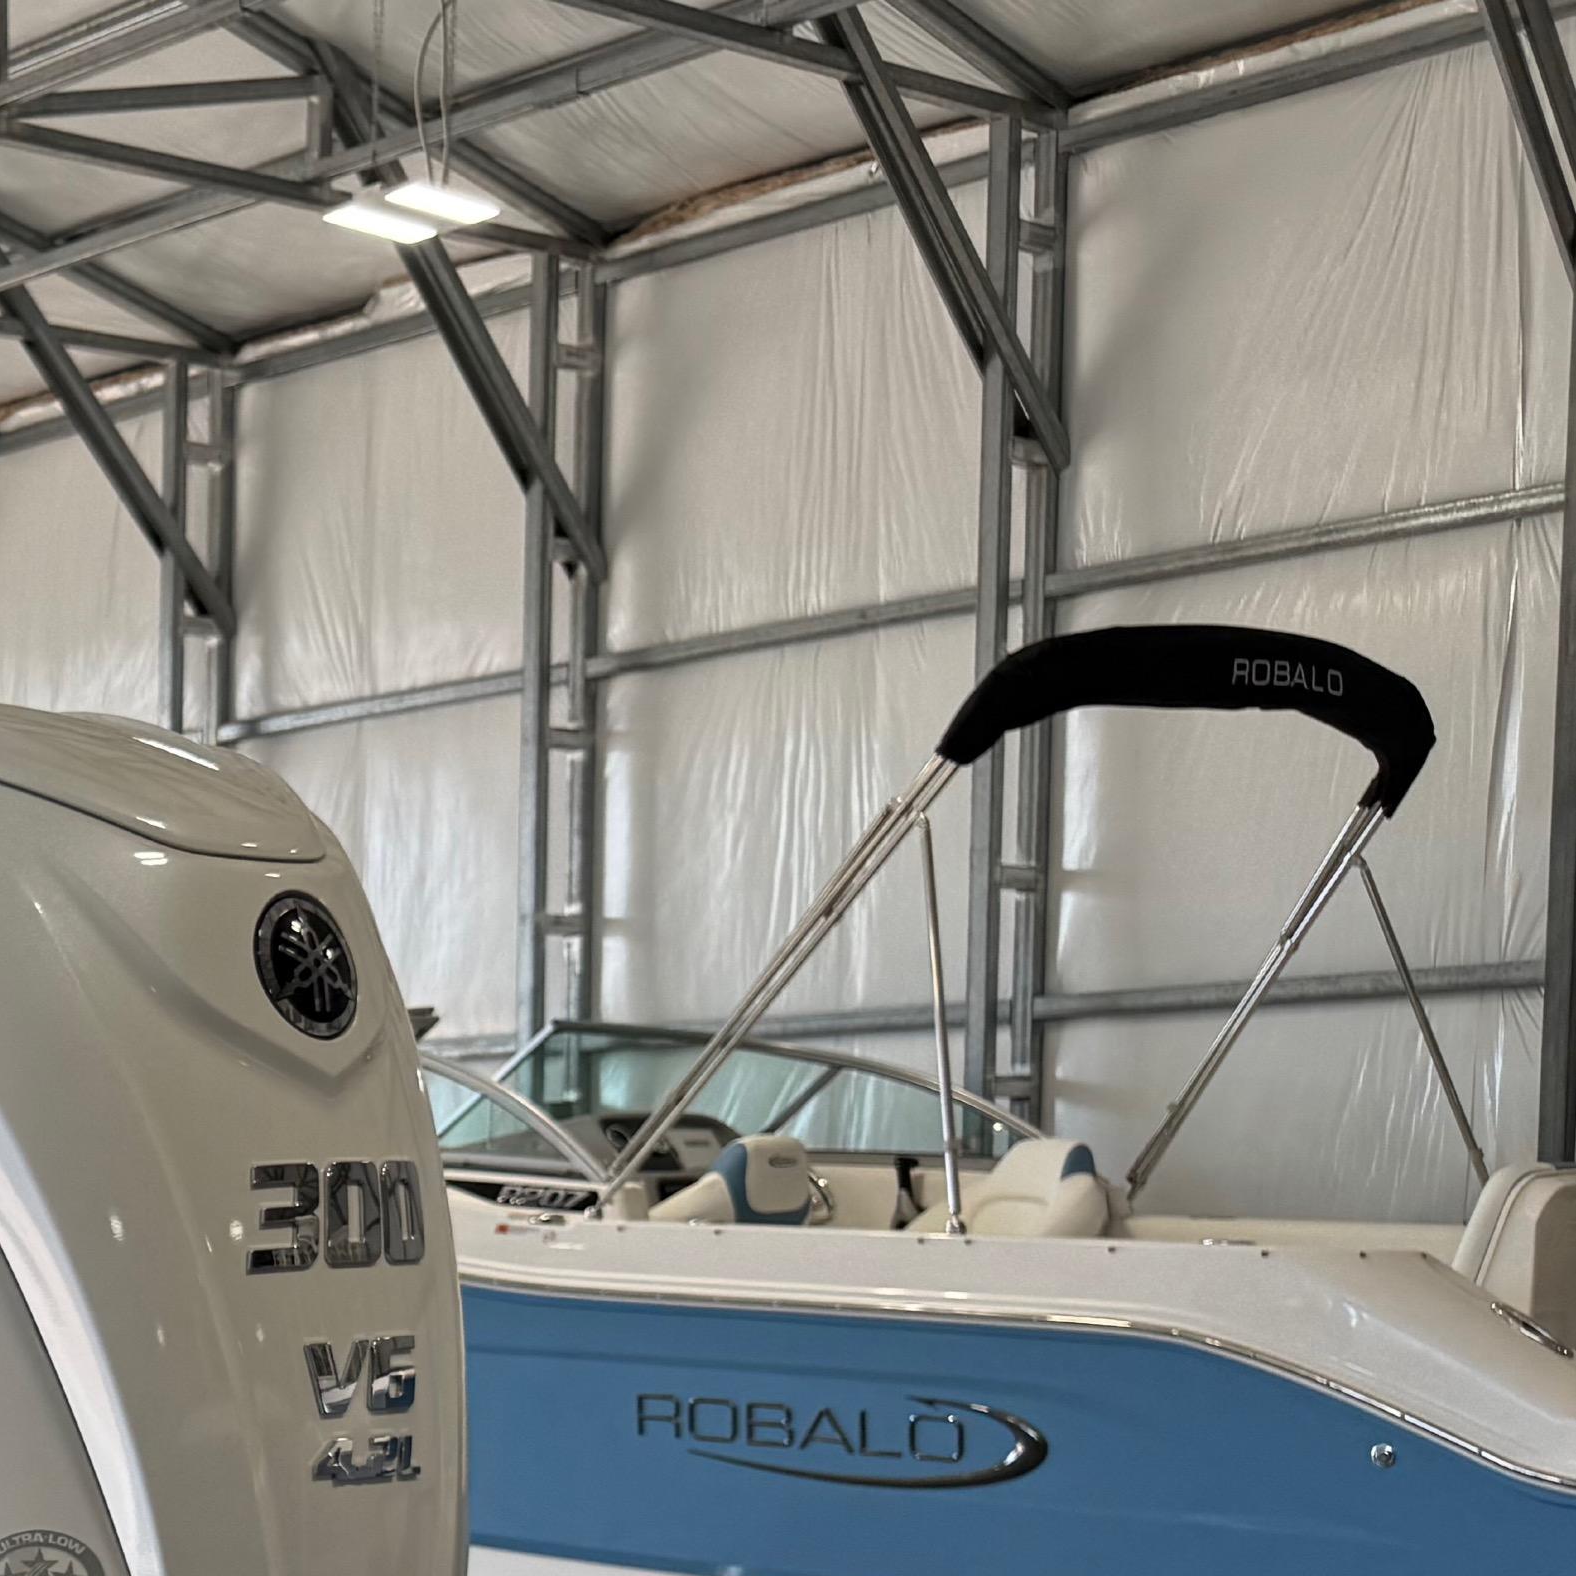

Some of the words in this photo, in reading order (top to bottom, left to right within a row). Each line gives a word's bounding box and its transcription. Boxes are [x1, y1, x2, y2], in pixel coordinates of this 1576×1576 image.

[1231, 657, 1344, 697] ROBALO
[247, 1160, 425, 1276] 300
[303, 1334, 416, 1418] V6
[636, 1393, 965, 1464] ROBALO
